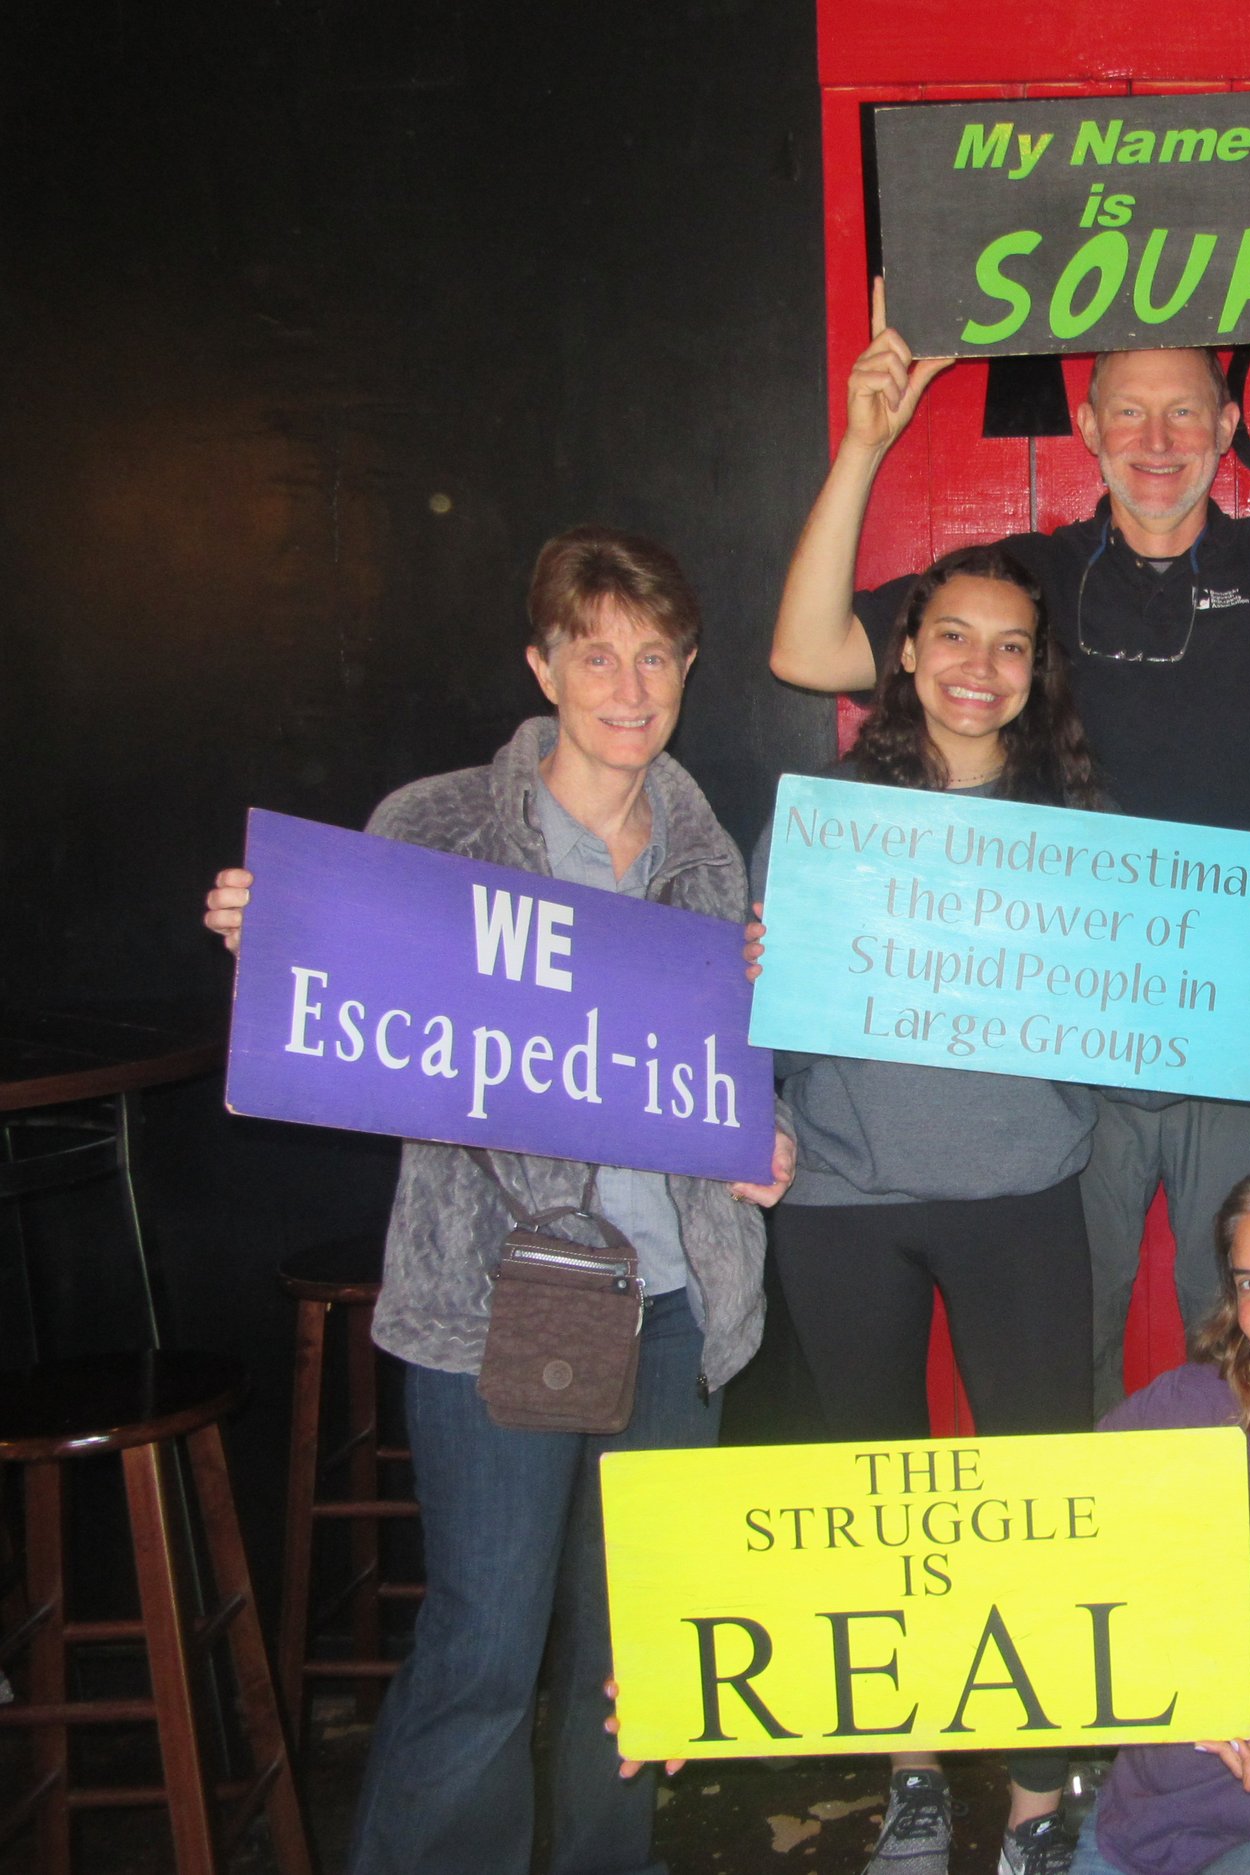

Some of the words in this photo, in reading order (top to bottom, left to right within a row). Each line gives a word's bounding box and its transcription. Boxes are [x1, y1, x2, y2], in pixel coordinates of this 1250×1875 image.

[953, 122, 1054, 181] My
[1079, 183, 1136, 228] is
[786, 806, 932, 858] Never
[473, 884, 573, 992] WE
[884, 878, 961, 923] the
[974, 889, 1133, 941] Power
[1146, 909, 1200, 949] of
[849, 936, 1005, 994] Stupid
[1016, 953, 1166, 1011] People
[1178, 970, 1217, 1012] in
[285, 966, 740, 1127] Escaped-ish
[864, 996, 1006, 1056] Large
[1020, 1015, 1188, 1075] Groups
[856, 1450, 983, 1495] THE
[745, 1496, 1100, 1552] STRUGGLE
[902, 1554, 951, 1596] IS
[681, 1602, 1179, 1743] REAL
